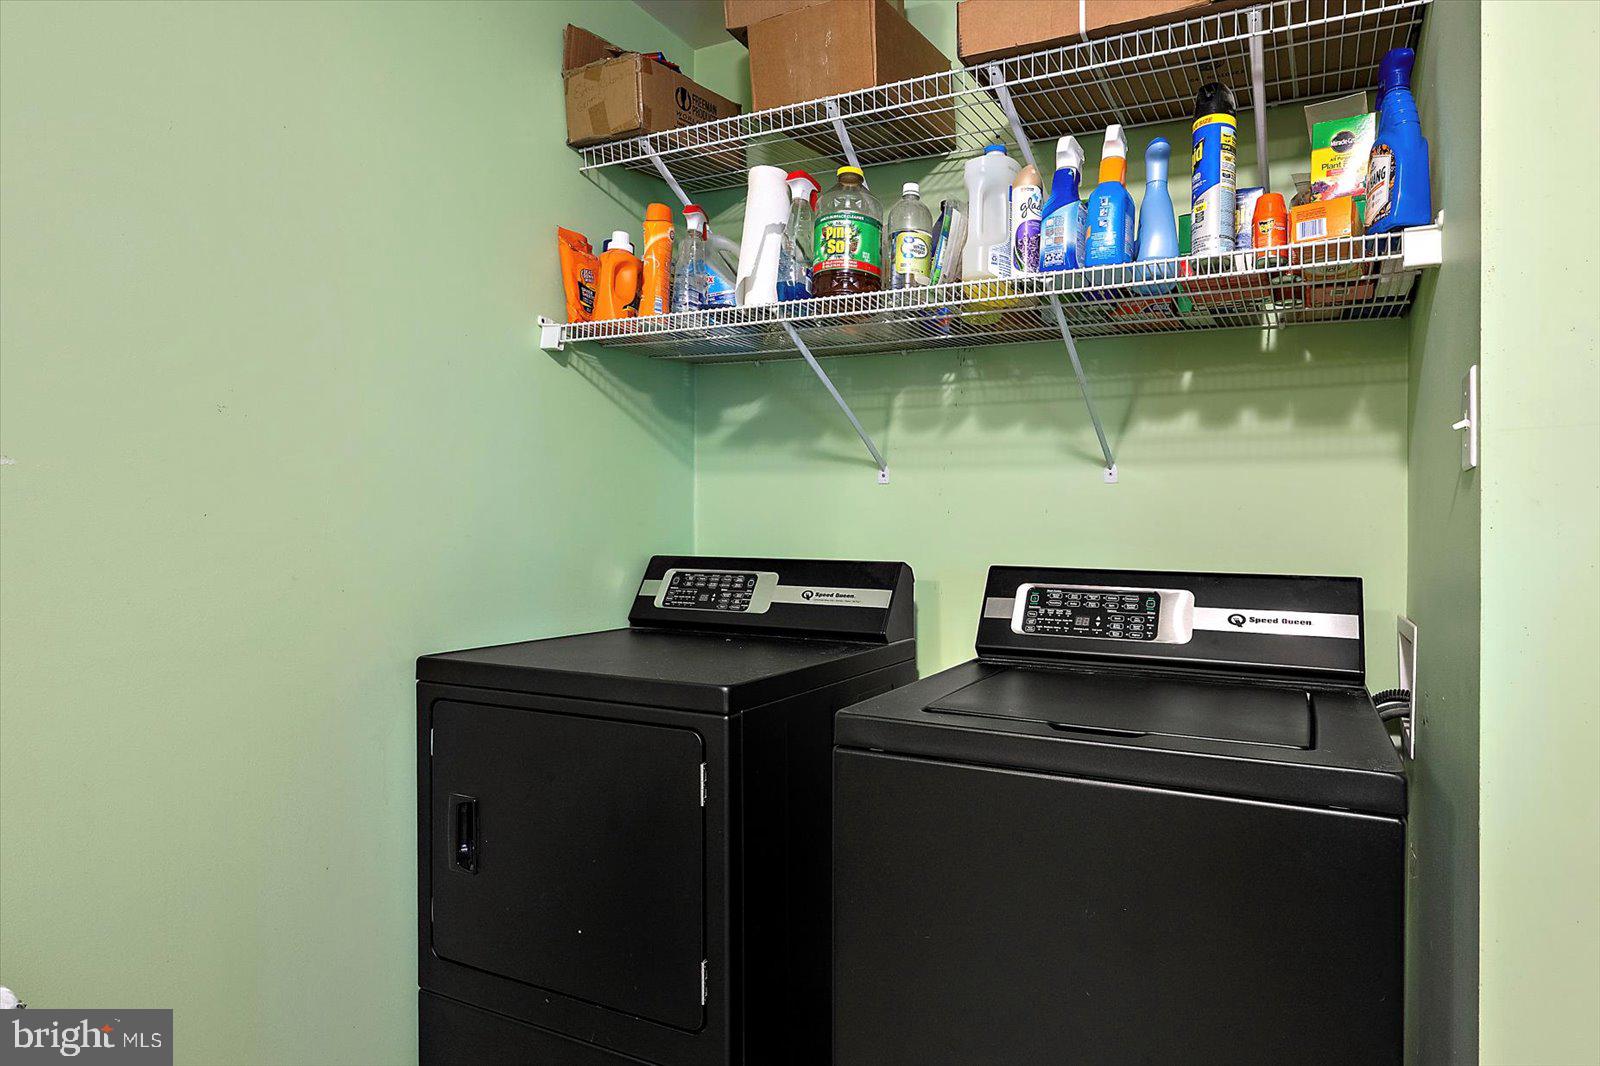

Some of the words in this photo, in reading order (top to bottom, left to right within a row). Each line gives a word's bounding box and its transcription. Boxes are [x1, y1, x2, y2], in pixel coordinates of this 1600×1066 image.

[1321, 161, 1342, 170] Plant
[1020, 196, 1042, 218] glad
[1249, 616, 1279, 624] Speed
[1281, 618, 1312, 626] Queen
